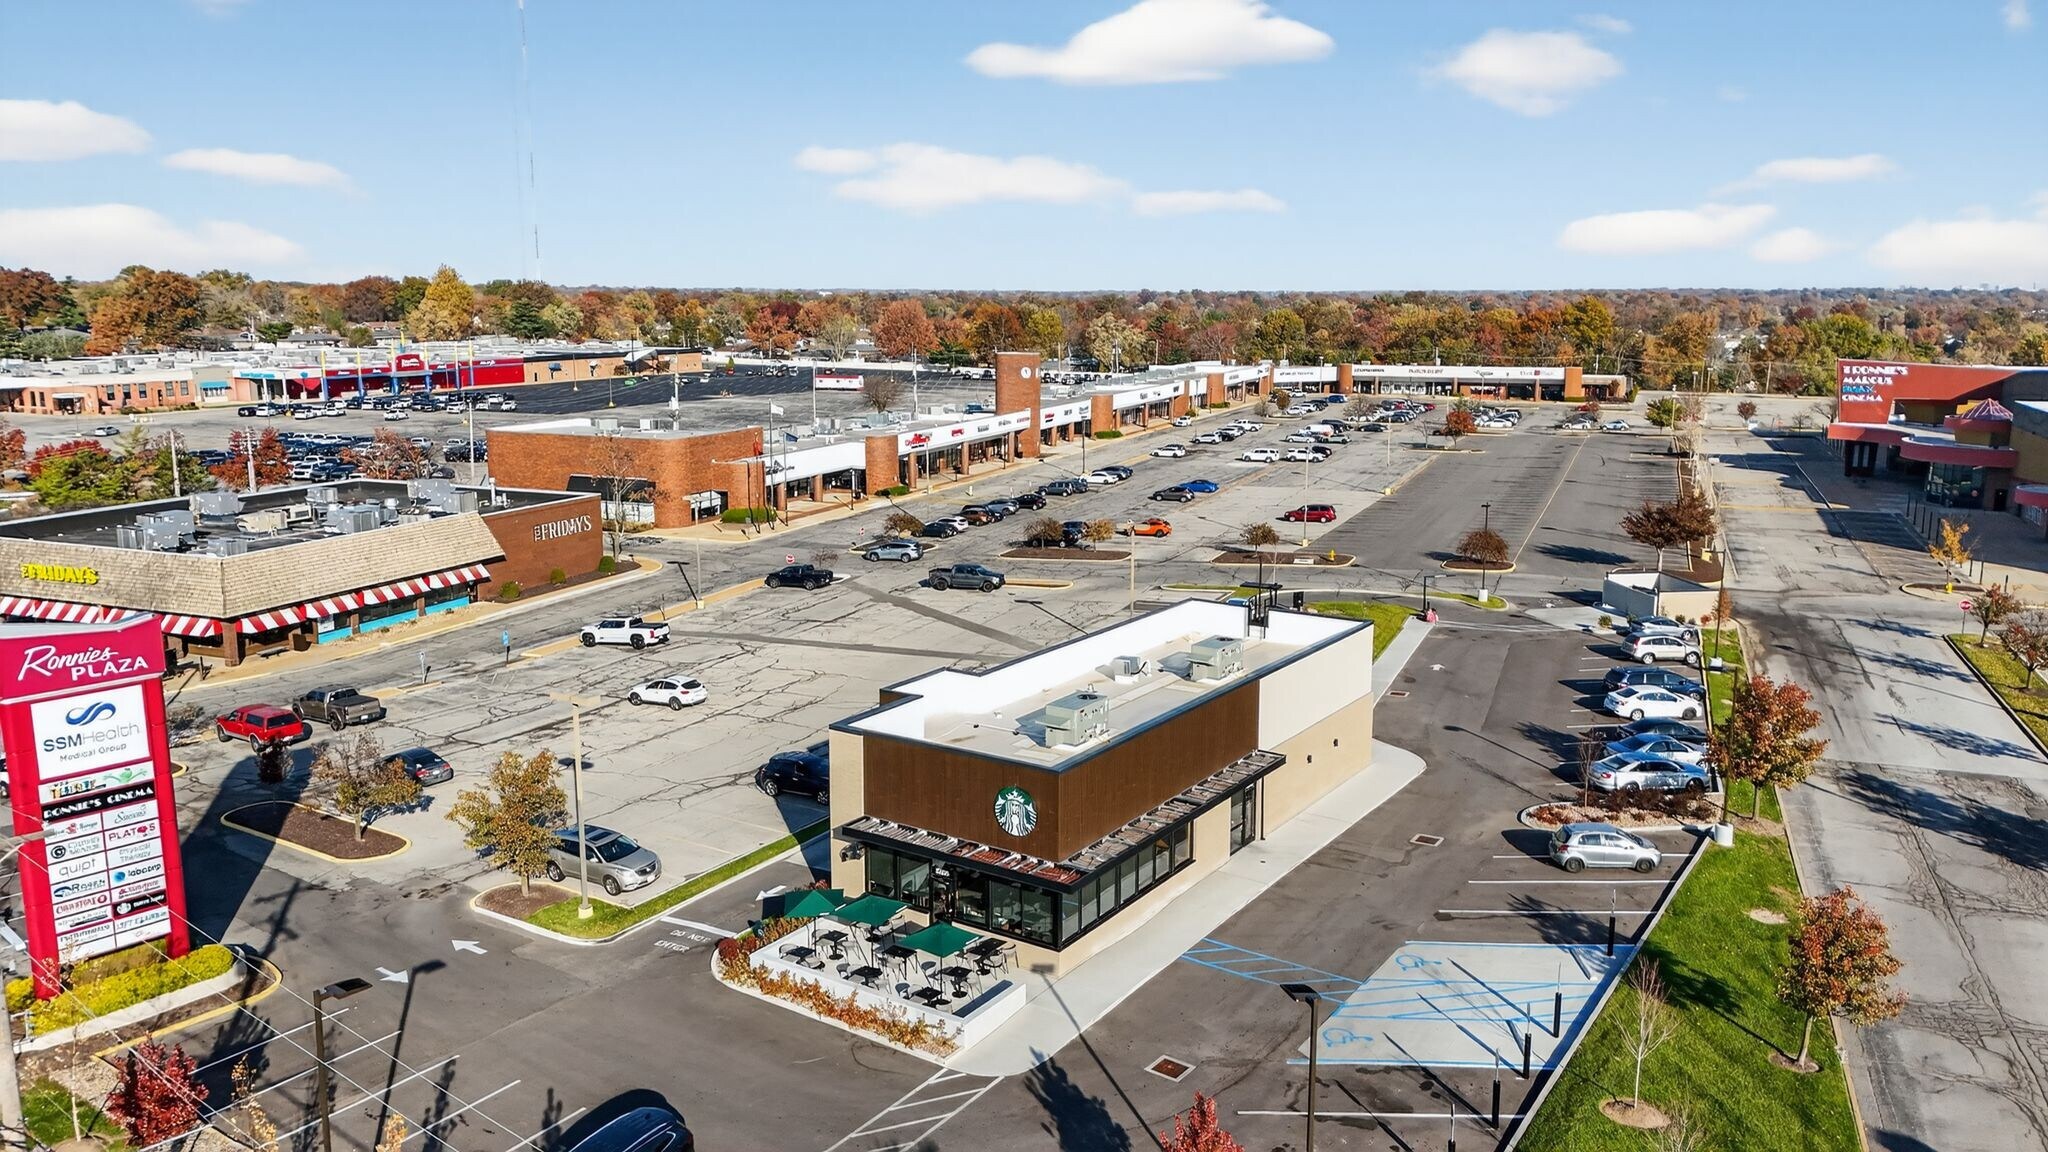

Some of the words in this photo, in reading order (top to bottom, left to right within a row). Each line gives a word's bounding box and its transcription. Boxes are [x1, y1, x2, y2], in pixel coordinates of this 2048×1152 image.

[71, 656, 148, 681] PLAZA
[60, 749, 96, 762] Medical
[98, 743, 127, 754] Group
[43, 798, 102, 819] RONNIE'S
[107, 786, 154, 804] CINEMA
[58, 857, 96, 878] quipt
[670, 929, 686, 937] DO
[687, 933, 711, 943] NOT
[654, 940, 690, 953] ENTER
